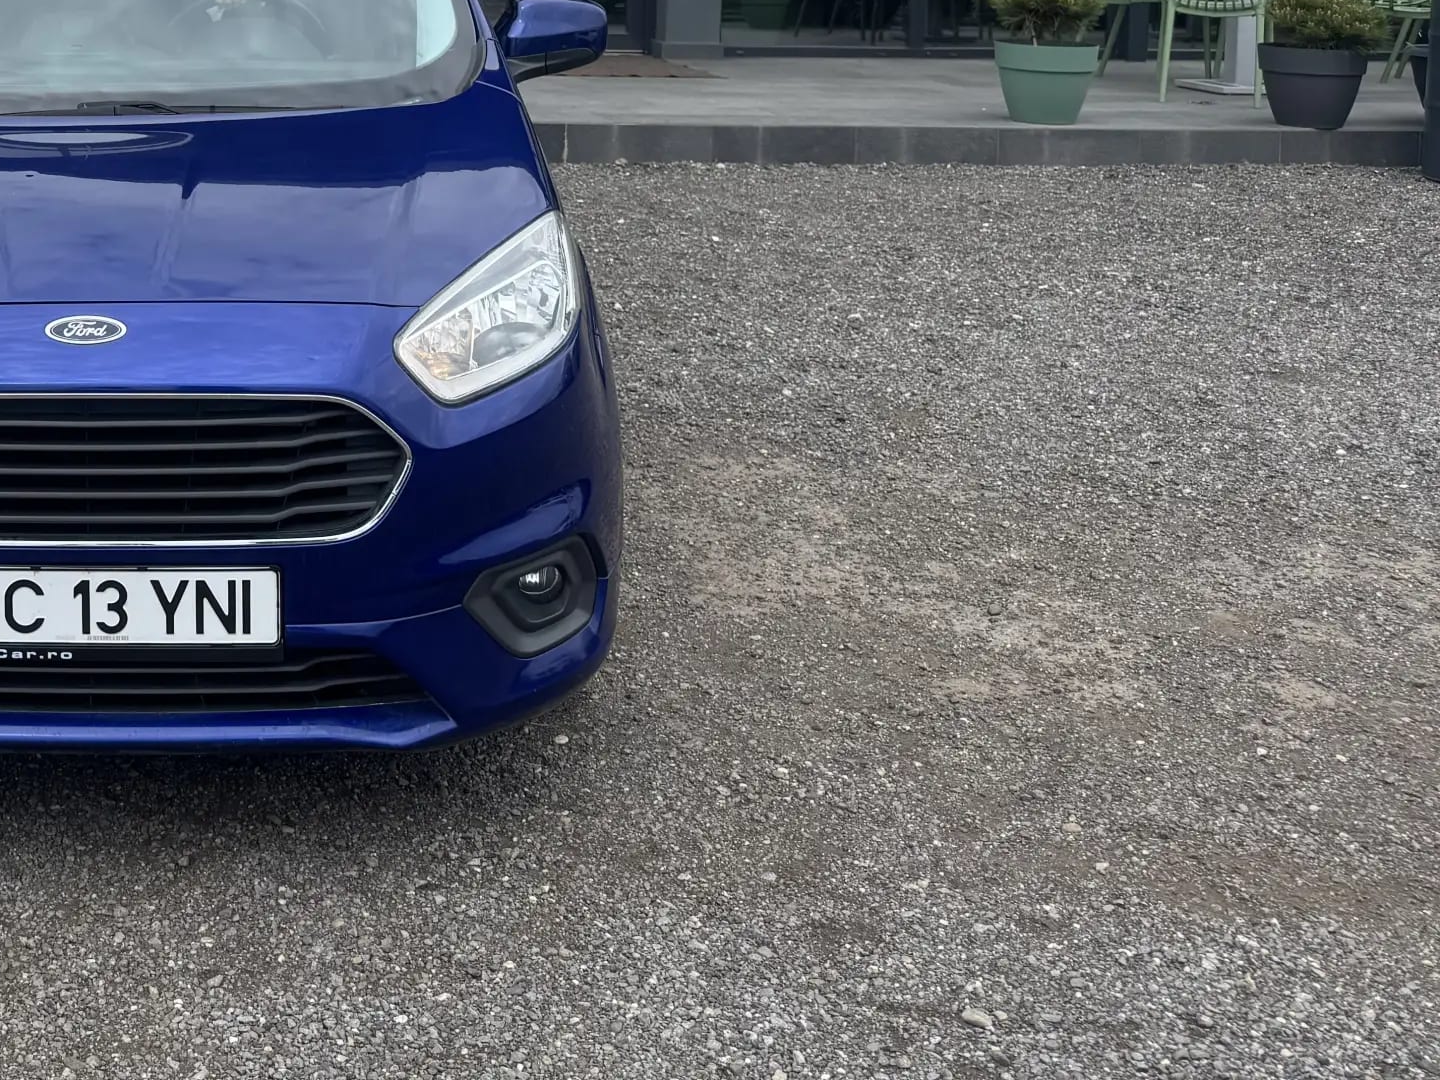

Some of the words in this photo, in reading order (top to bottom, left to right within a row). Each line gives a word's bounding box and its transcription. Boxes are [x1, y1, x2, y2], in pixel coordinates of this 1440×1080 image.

[63, 321, 107, 337] Ford
[73, 579, 128, 634] 13
[150, 579, 251, 635] YNI
